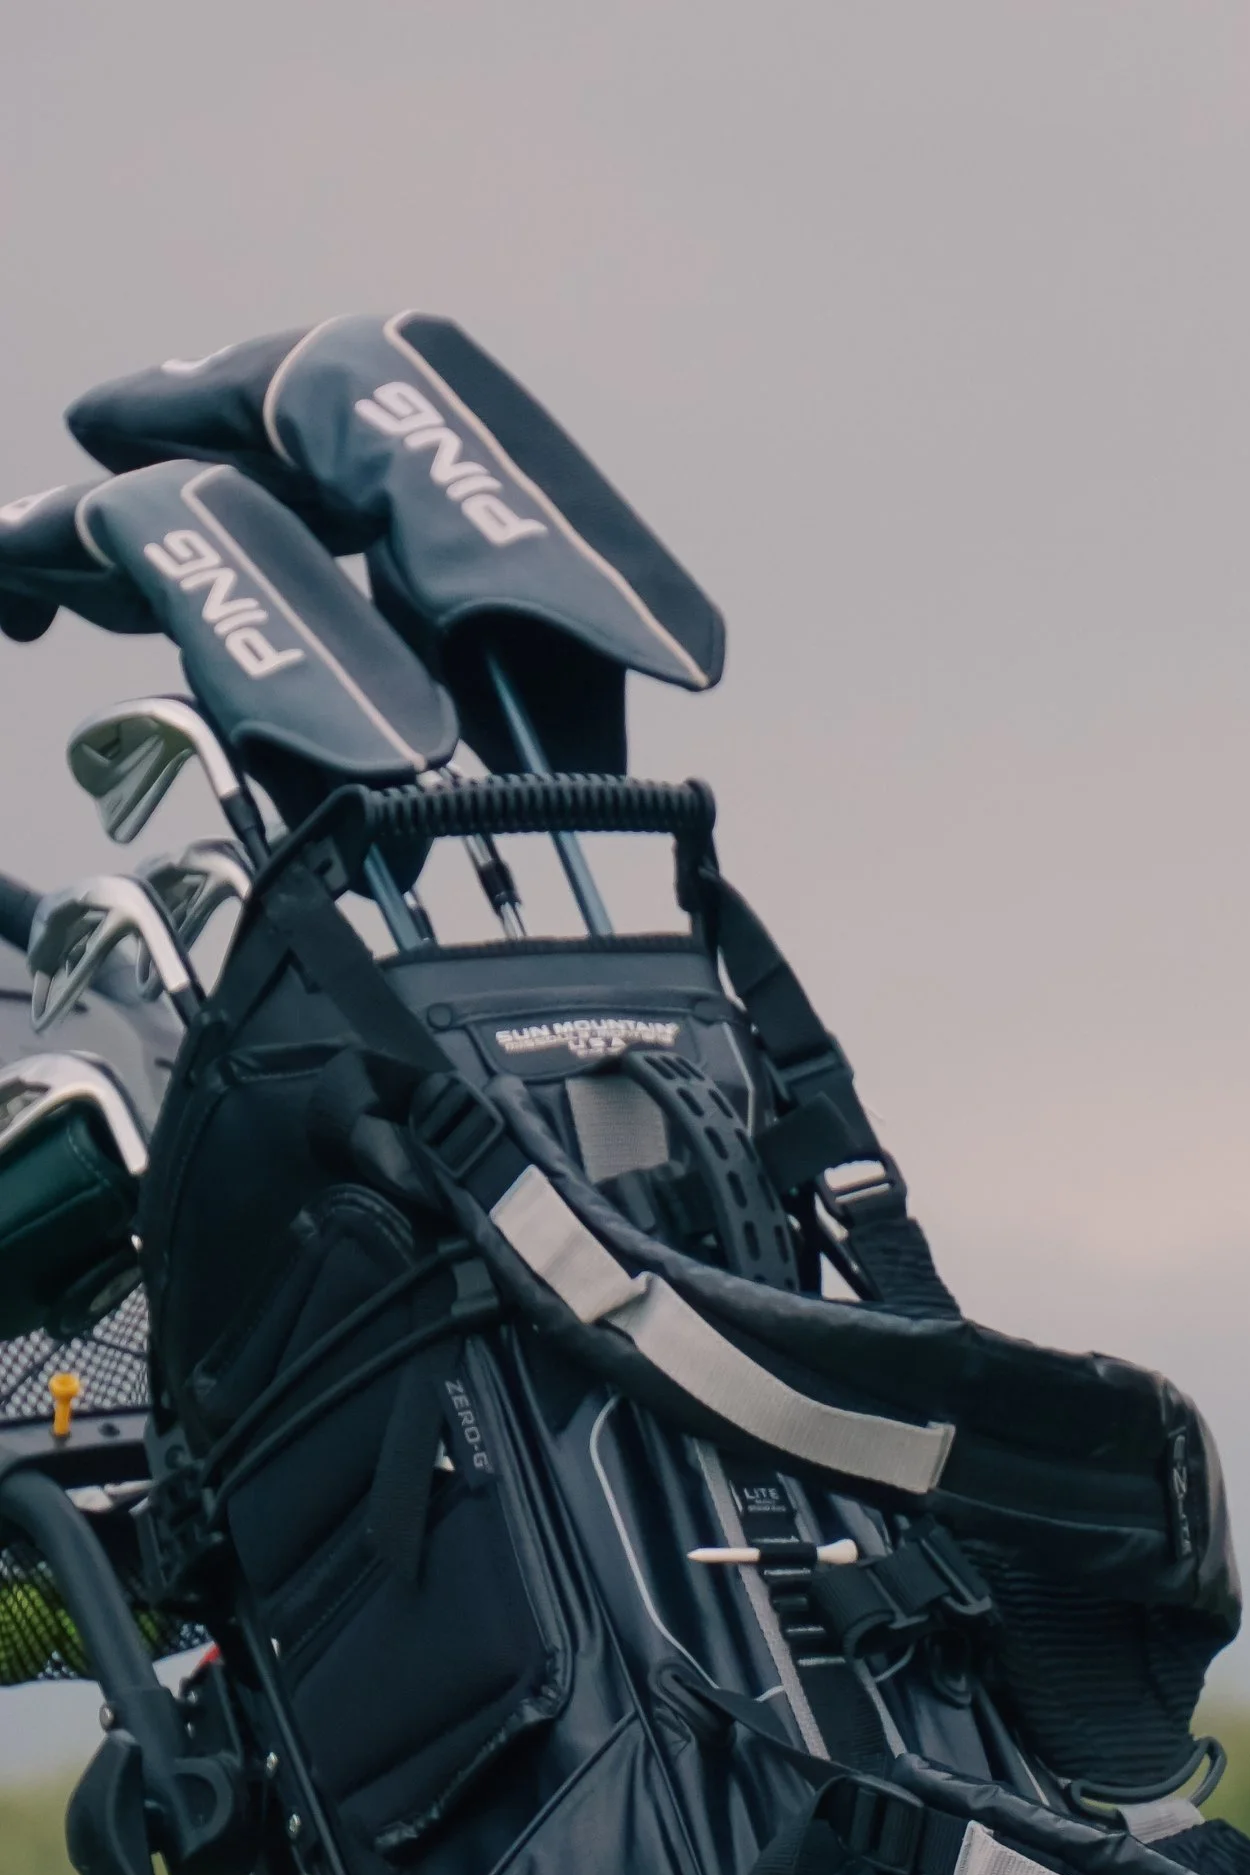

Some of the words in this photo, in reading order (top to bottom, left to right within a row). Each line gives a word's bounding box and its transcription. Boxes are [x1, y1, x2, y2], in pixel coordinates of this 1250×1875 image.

[355, 382, 547, 546] PING
[144, 530, 304, 678] PING
[496, 1025, 550, 1043] SUN
[553, 1019, 679, 1040] MOUNTAIN
[445, 1380, 490, 1471] ZERO-G
